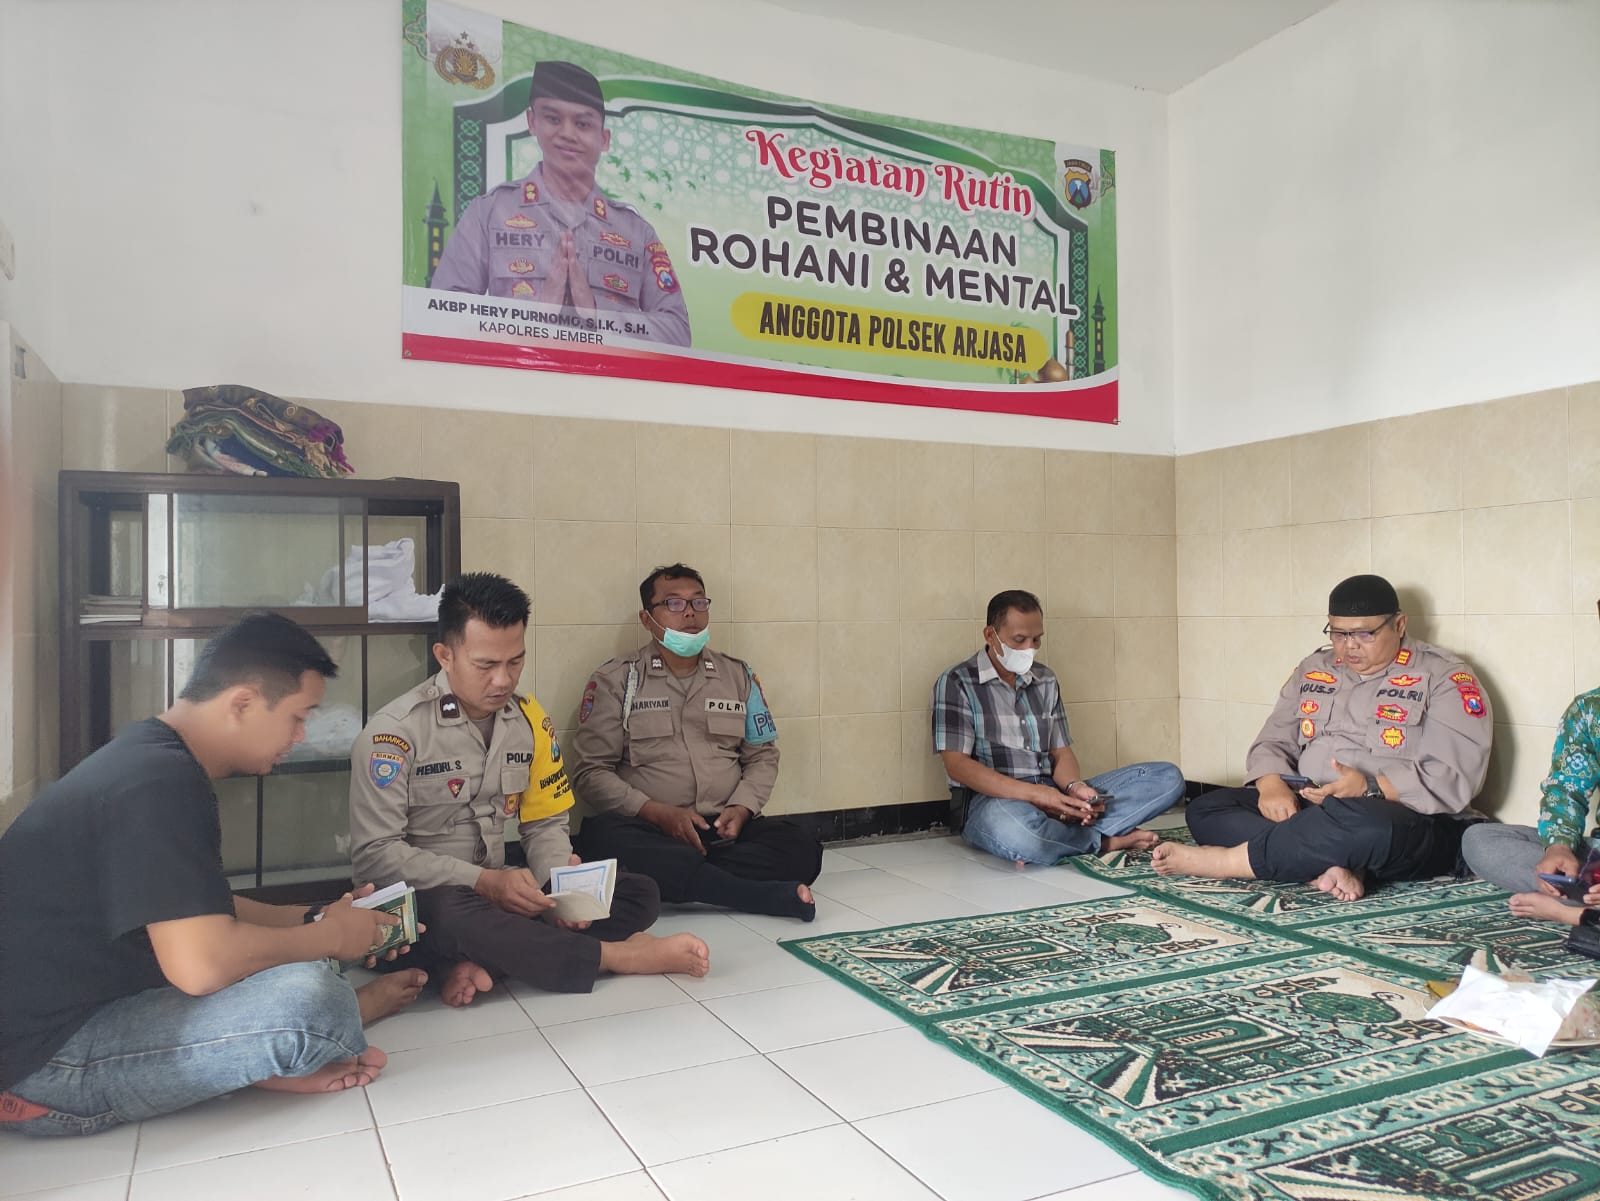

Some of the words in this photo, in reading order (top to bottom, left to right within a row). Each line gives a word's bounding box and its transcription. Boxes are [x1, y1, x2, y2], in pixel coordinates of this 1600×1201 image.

[746, 130, 926, 198] Kegiatan
[934, 164, 1032, 217] Rutin
[495, 232, 545, 247] HERY
[767, 196, 1017, 267] PEMBINAAN
[593, 245, 639, 269] POLRI
[690, 227, 869, 289] ROHANI
[884, 258, 911, 294] &
[925, 264, 1080, 316] MENTAL
[427, 298, 467, 313] AKBP
[470, 303, 509, 318] HERY
[511, 308, 584, 329] PURNOMO,
[624, 322, 649, 335] S.H.
[479, 321, 549, 339] KAPOLRES
[552, 330, 603, 345] JEMBER
[759, 301, 861, 346] ANGGOTA
[868, 318, 947, 354] POLSEK
[953, 327, 1027, 364] ARJASA
[1376, 688, 1424, 702] POLRI
[454, 759, 462, 770] S
